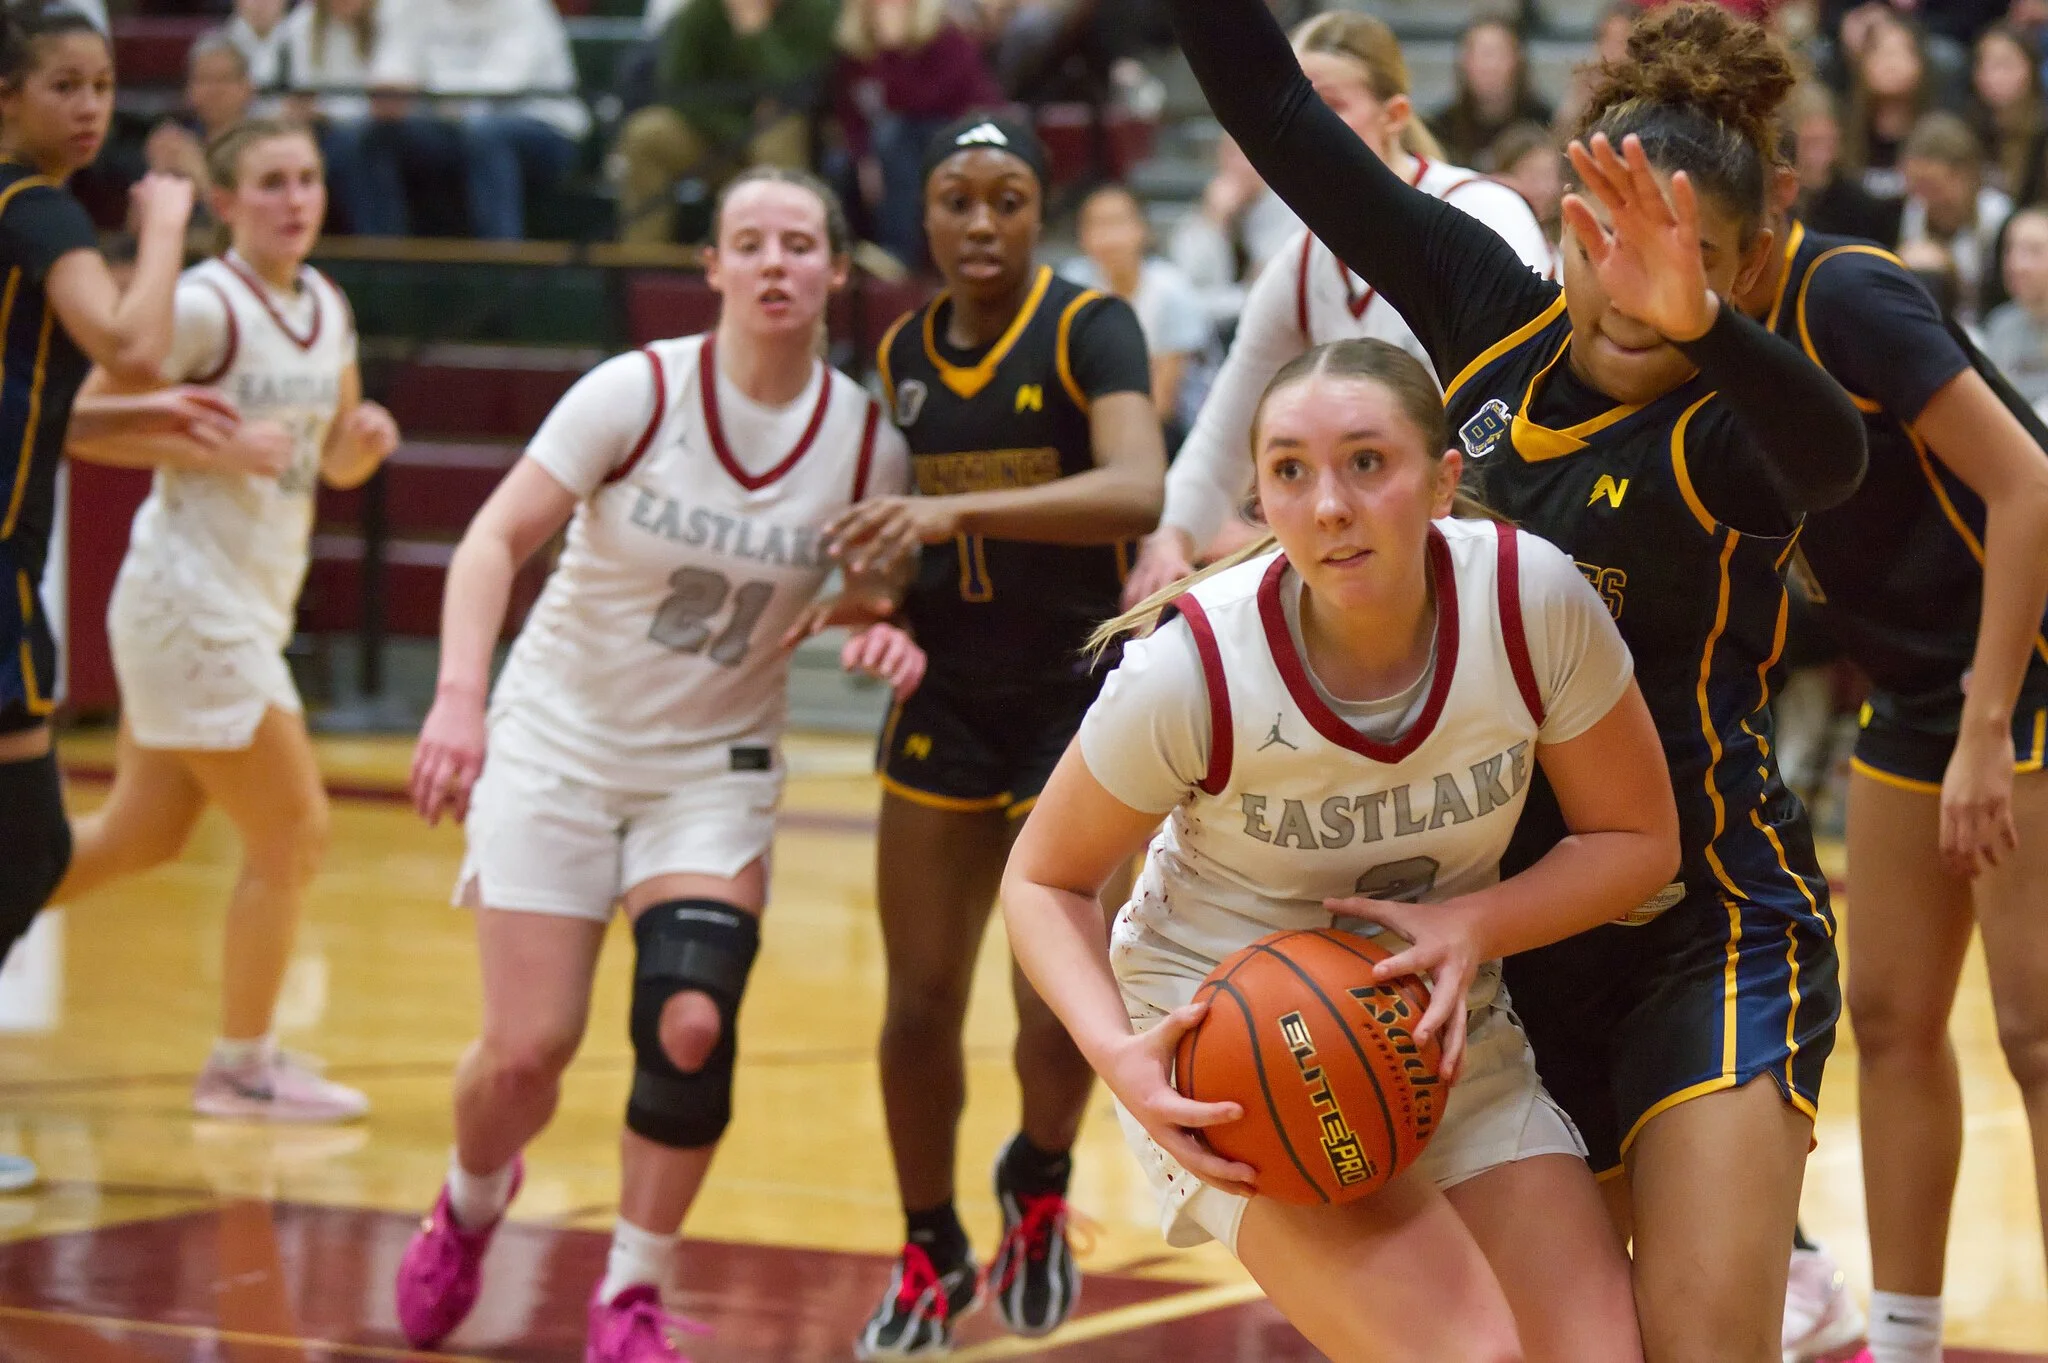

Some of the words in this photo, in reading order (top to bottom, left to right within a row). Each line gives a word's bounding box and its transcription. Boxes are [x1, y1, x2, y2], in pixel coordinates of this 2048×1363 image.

[648, 565, 776, 669] 21
[1240, 739, 1529, 850] EASTLAKE
[1278, 1010, 1351, 1147] ELITE
[1325, 1136, 1375, 1187] PRO
[1346, 984, 1440, 1140] Baden
